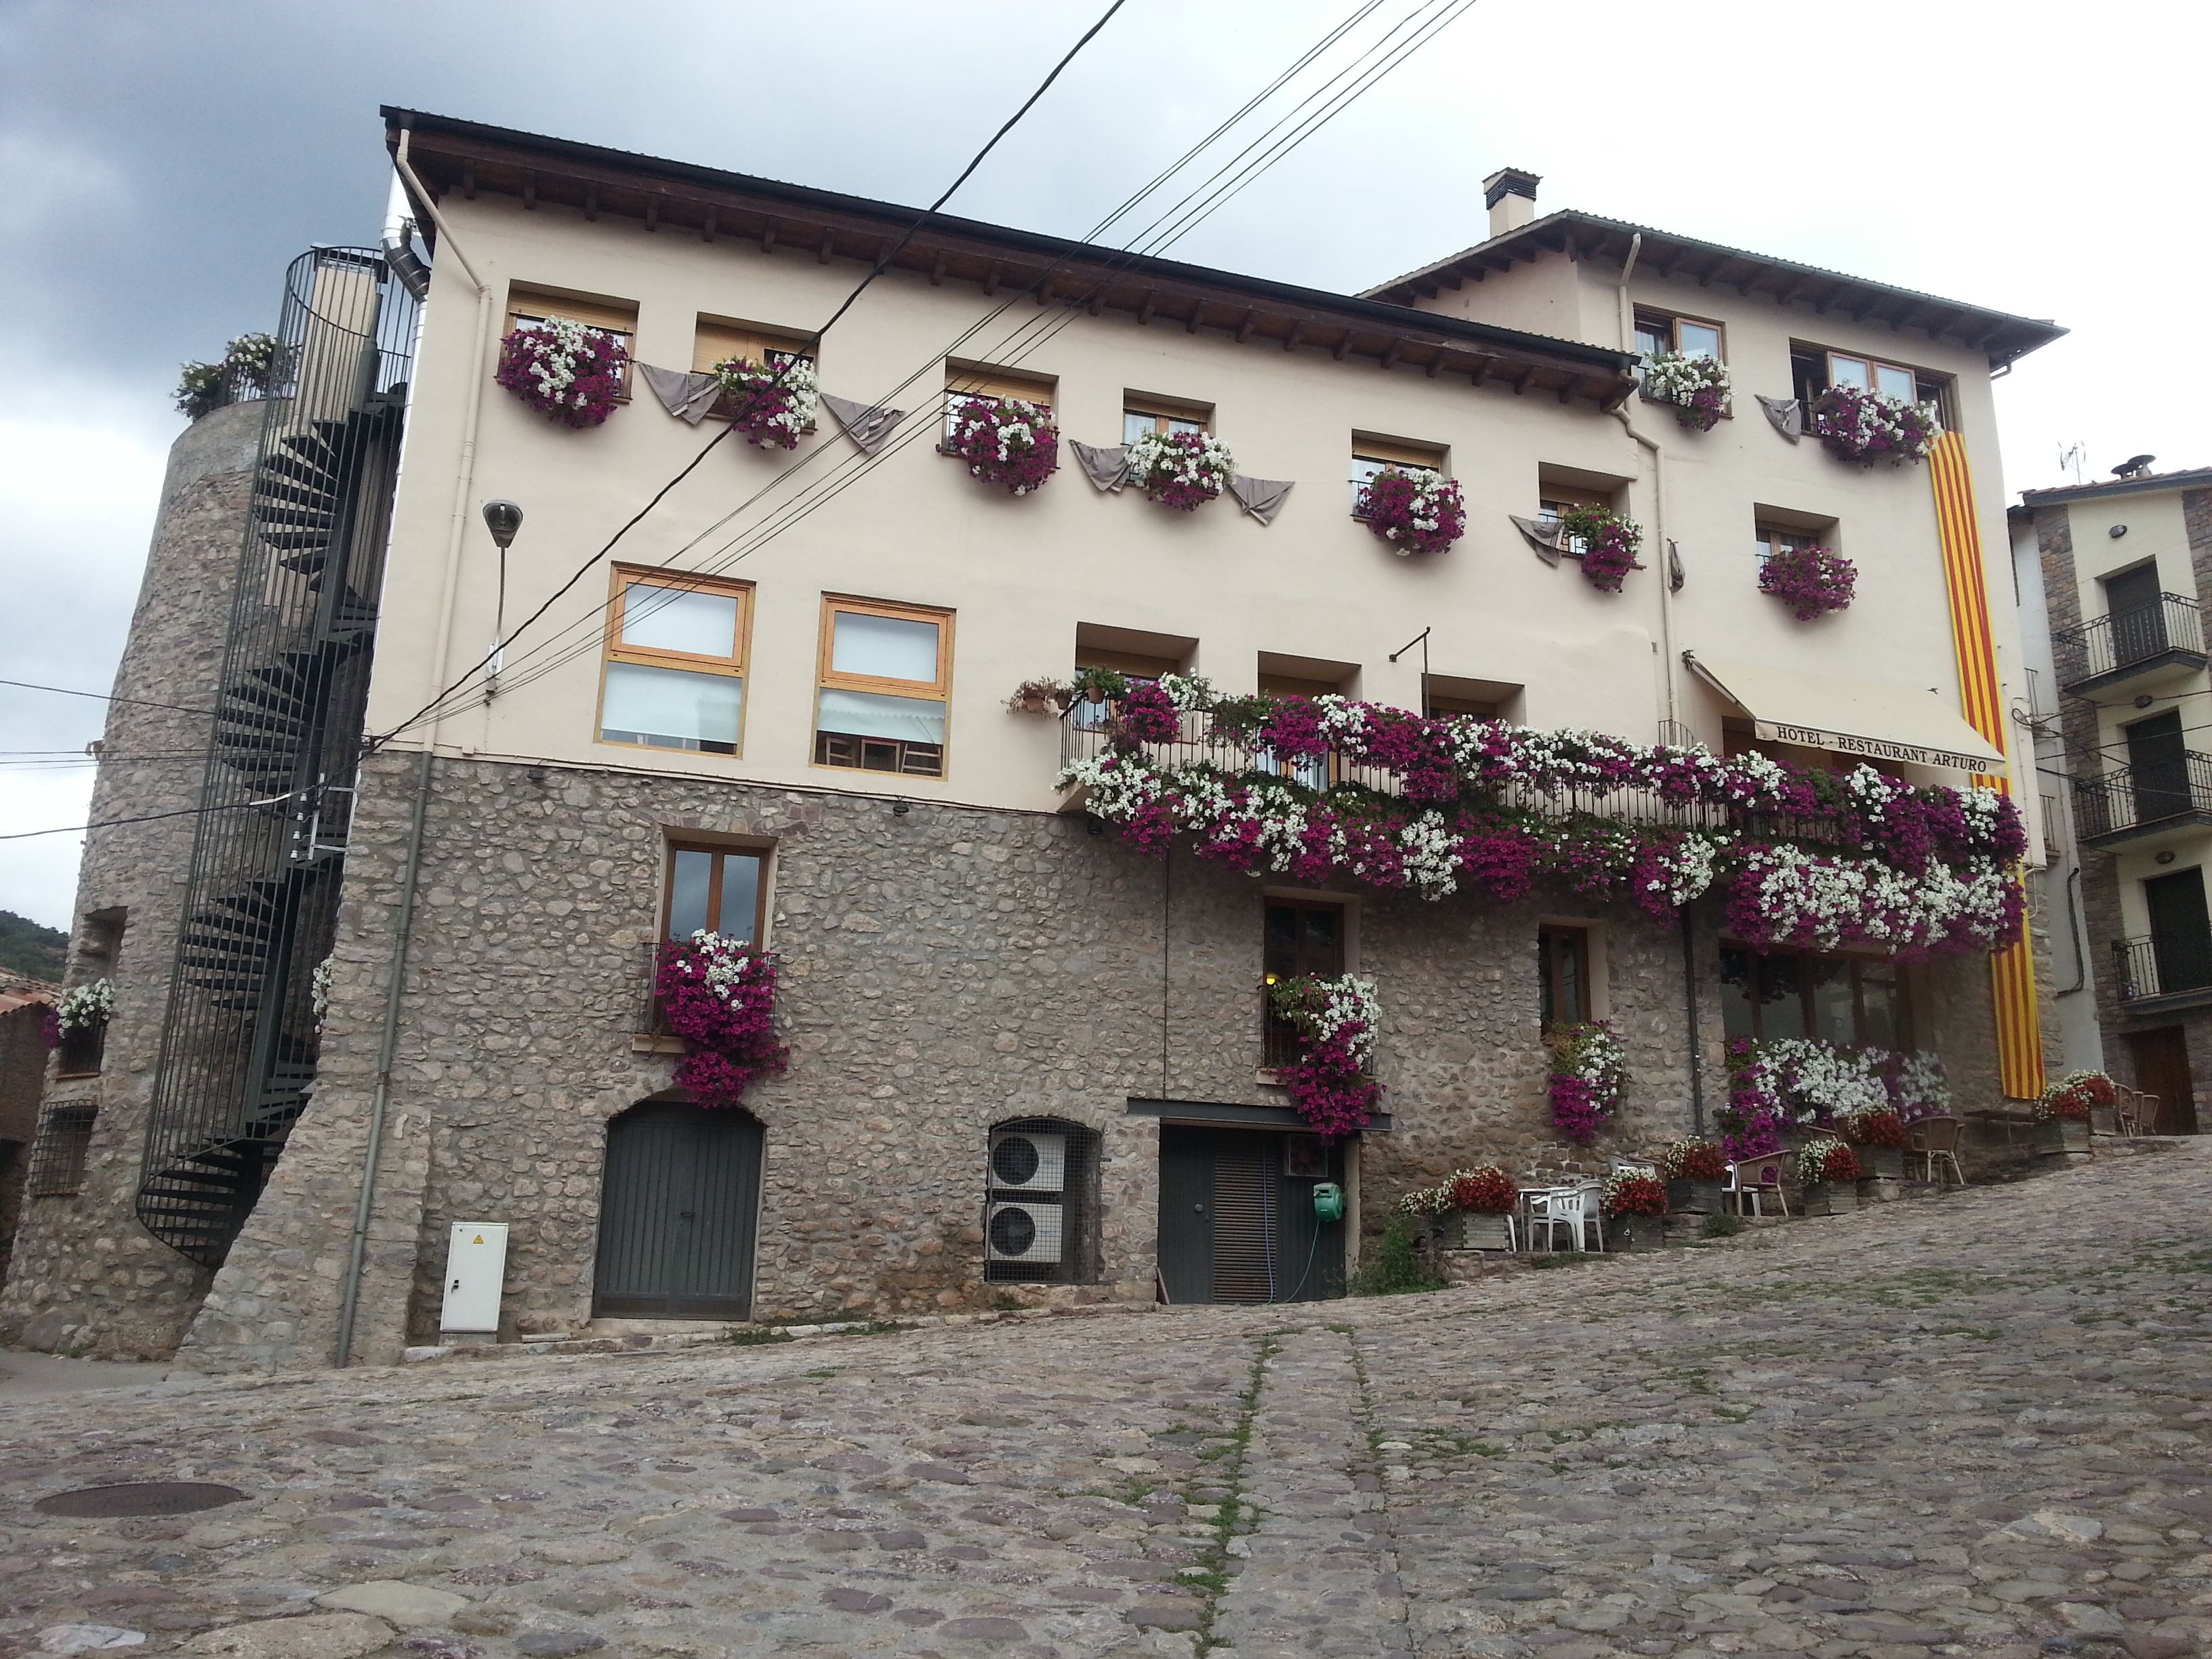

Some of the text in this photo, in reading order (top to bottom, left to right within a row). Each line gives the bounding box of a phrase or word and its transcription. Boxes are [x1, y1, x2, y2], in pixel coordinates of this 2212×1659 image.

[1777, 726, 1824, 745] HOTEL
[1837, 737, 1927, 762] RESTAURANT
[1932, 753, 1986, 773] ARTURO
